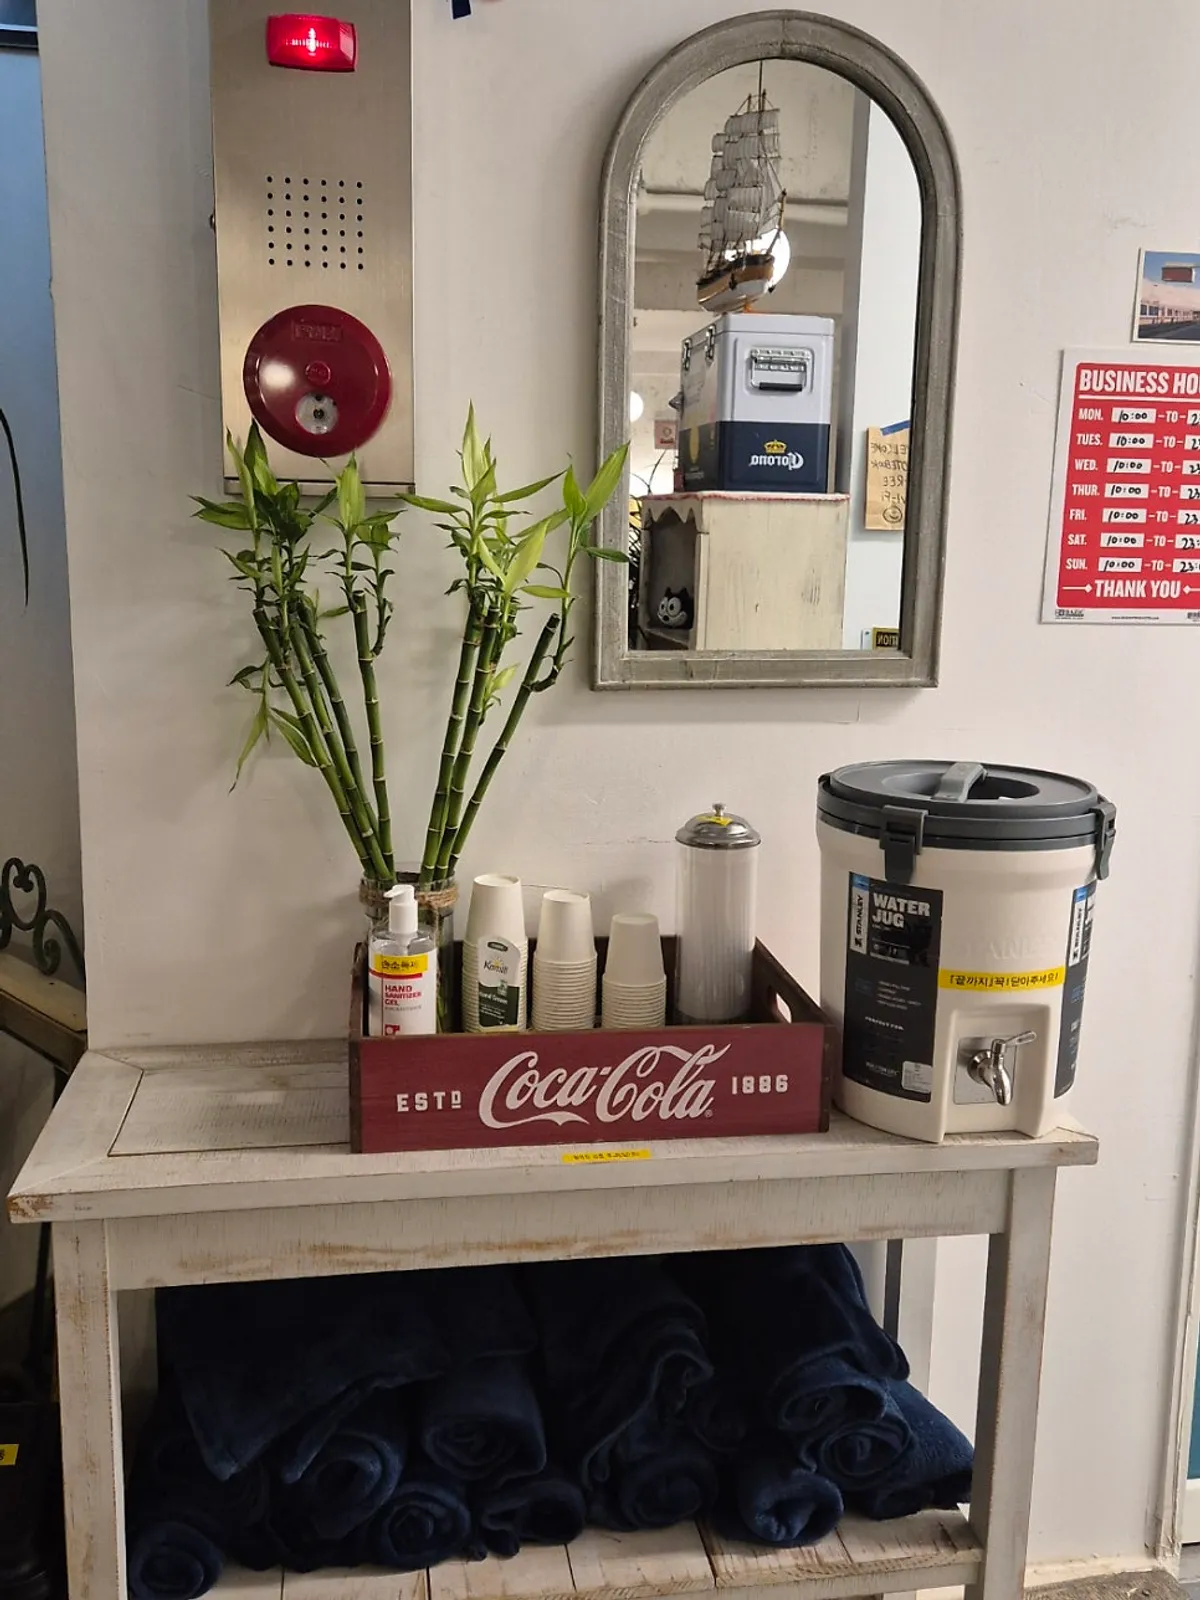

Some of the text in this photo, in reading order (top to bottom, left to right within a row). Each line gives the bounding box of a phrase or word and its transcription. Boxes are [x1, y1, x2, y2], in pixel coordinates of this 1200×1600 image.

[1079, 369, 1200, 396] BUSINESS HO
[1078, 408, 1104, 421] MON.
[1119, 410, 1148, 424] 10:00
[1076, 433, 1103, 446] TUES.
[1116, 436, 1146, 447] 10:00
[1074, 458, 1098, 471] WED.
[1113, 460, 1143, 472] 10:00
[1072, 484, 1100, 496] THUR.
[1111, 485, 1142, 496] 10:00
[1069, 509, 1087, 521] FRI.
[1108, 510, 1139, 522] 10:00
[1067, 534, 1087, 545] SAT.
[1106, 535, 1137, 546] 10:00
[1065, 558, 1087, 570] SUN.
[1103, 560, 1135, 572] 10:00
[1180, 561, 1200, 573] 23:
[1094, 580, 1182, 598] THANK YOU
[873, 892, 931, 917] WATER
[855, 894, 864, 935] STANLEY
[871, 909, 905, 928] JUG
[397, 1043, 789, 1129] ESTD Coca-Cola 1886
